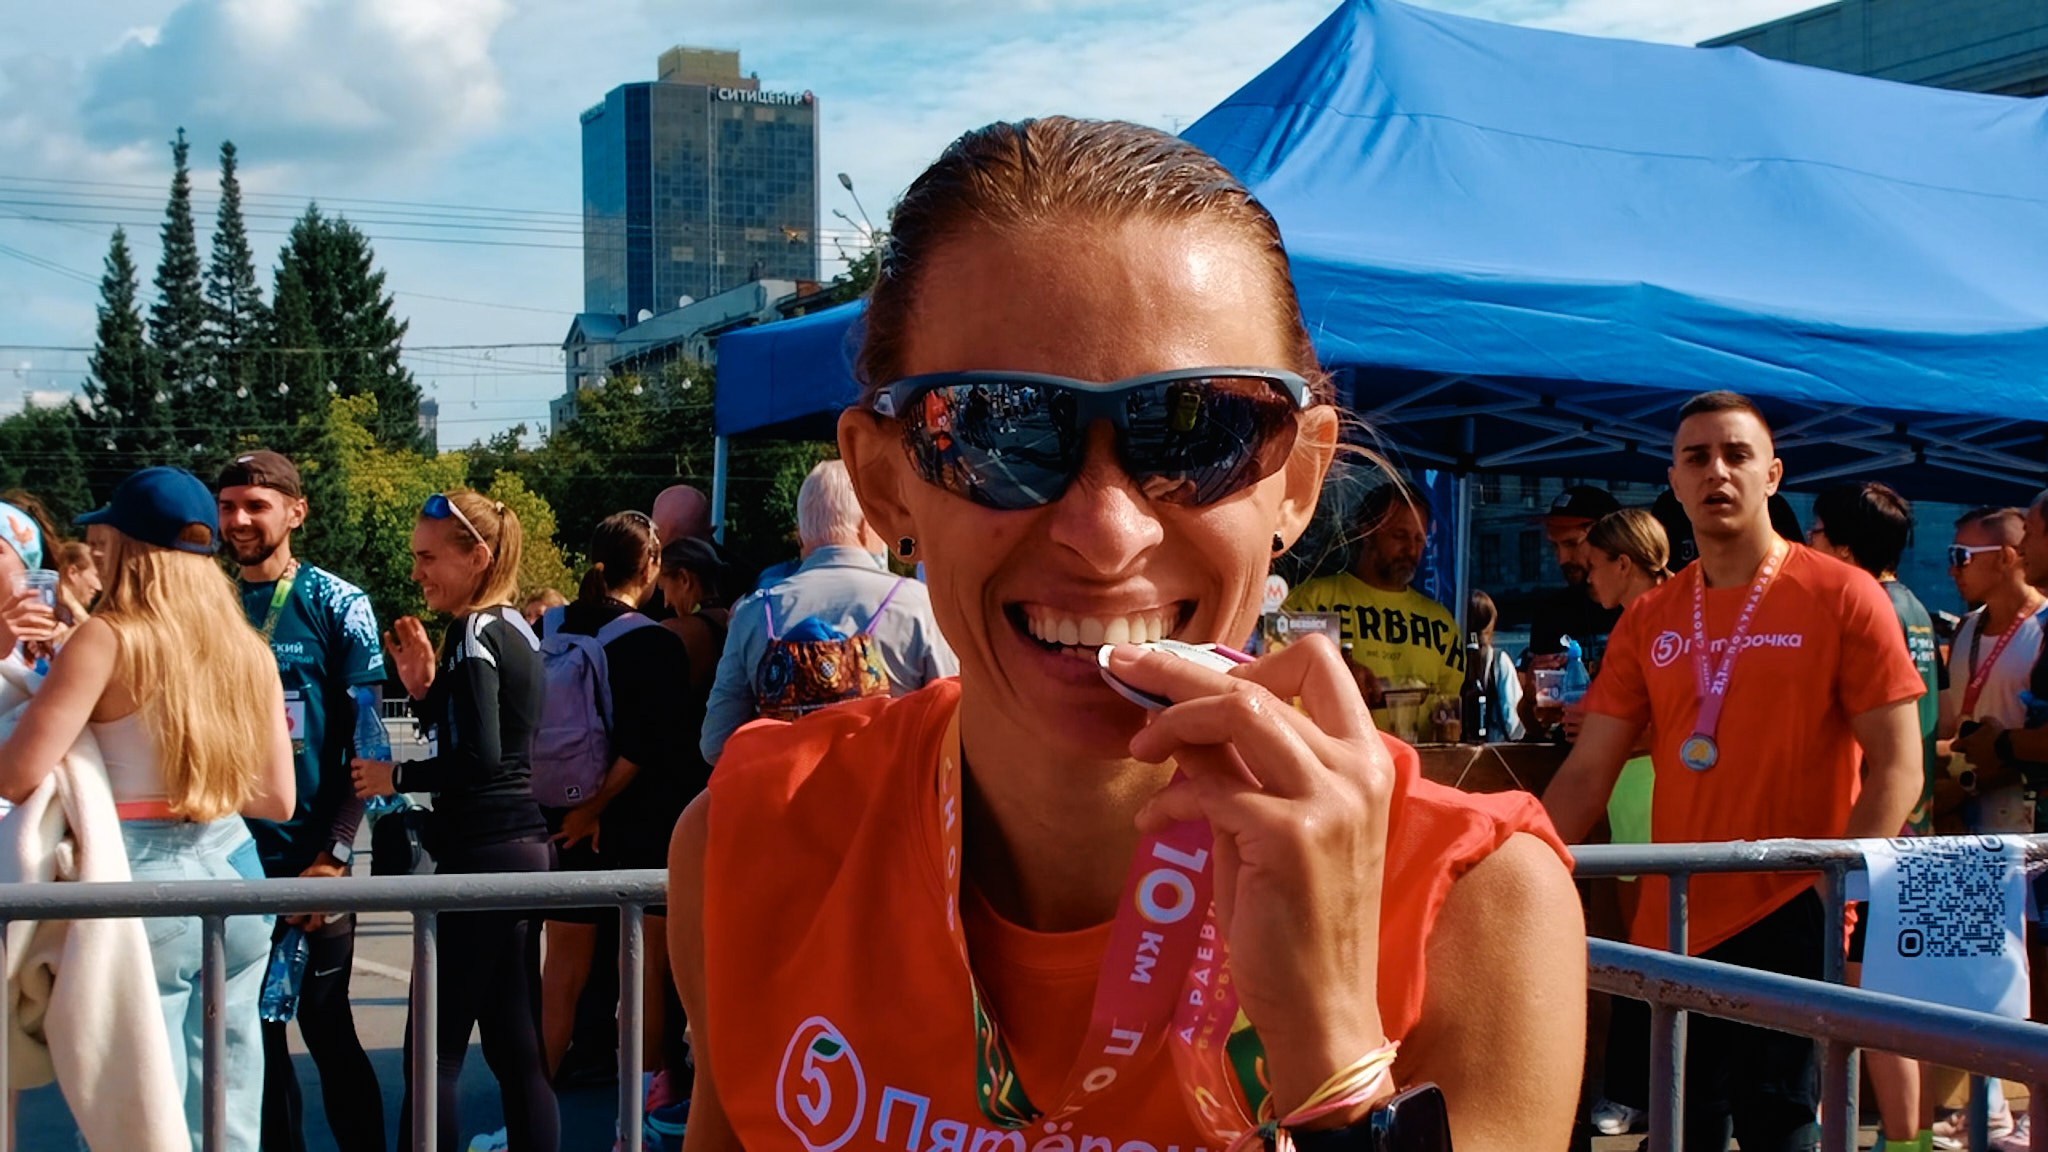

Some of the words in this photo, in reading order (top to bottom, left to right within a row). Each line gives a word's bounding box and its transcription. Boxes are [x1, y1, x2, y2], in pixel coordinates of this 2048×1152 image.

[718, 87, 802, 105] СИТИЦЕНТР
[1297, 604, 1466, 672] ERBACH
[1135, 842, 1209, 923] 10
[1130, 931, 1164, 984] КМ
[875, 1086, 1208, 1152] Пятё
